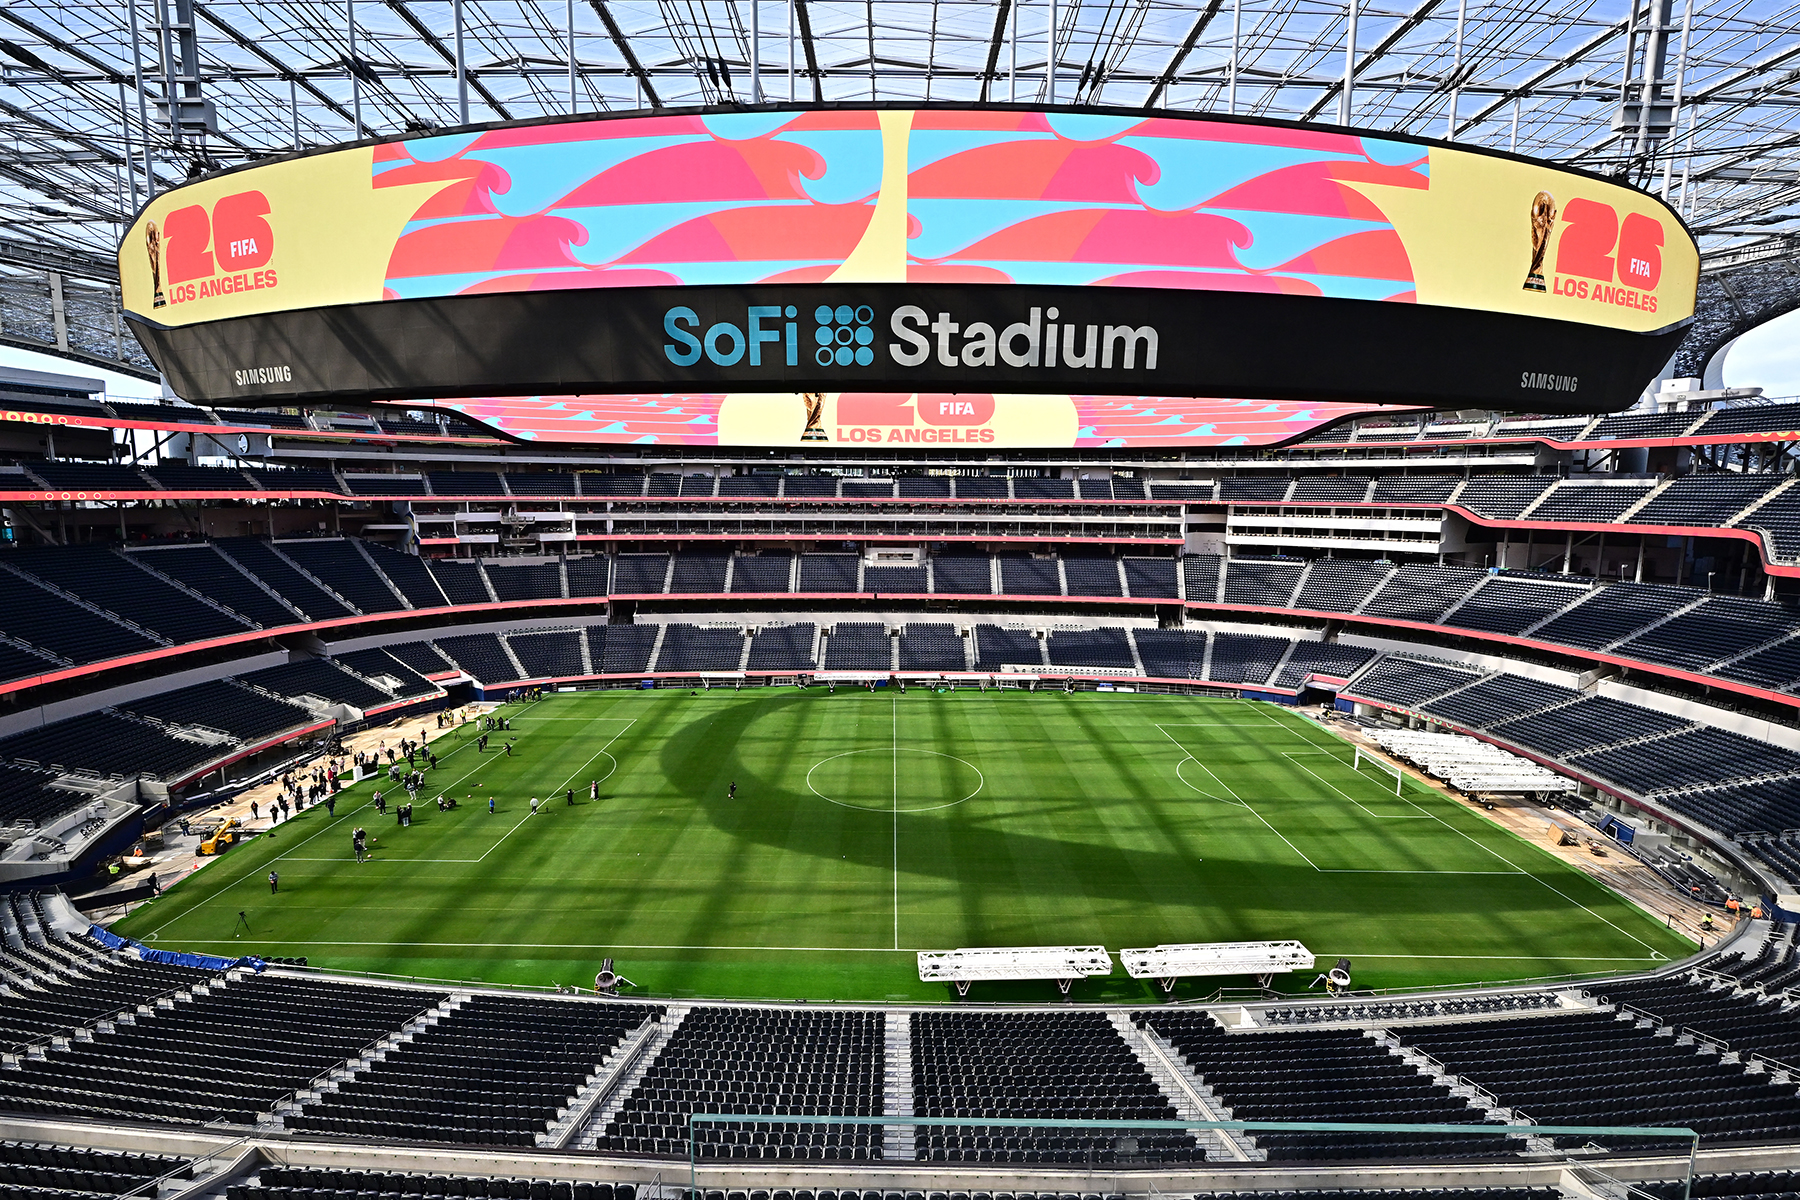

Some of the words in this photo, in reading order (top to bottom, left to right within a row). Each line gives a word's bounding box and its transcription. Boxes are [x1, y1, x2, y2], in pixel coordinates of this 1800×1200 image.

[163, 190, 274, 285] 26
[230, 238, 258, 258] FIFA
[1555, 197, 1665, 292] 26
[1629, 258, 1651, 278] FIFA
[169, 283, 196, 305] LOS
[199, 269, 278, 299] ANGELES
[1552, 276, 1589, 299] LOS
[1591, 284, 1658, 313] ANGELES
[663, 305, 798, 367] SoFi
[889, 304, 1159, 370] Stadium
[235, 365, 292, 386] SAMSUNG
[1520, 371, 1578, 392] SAMSUNG
[939, 402, 975, 415] FIFA
[836, 428, 882, 443] LOS
[887, 428, 995, 443] ANGELES
